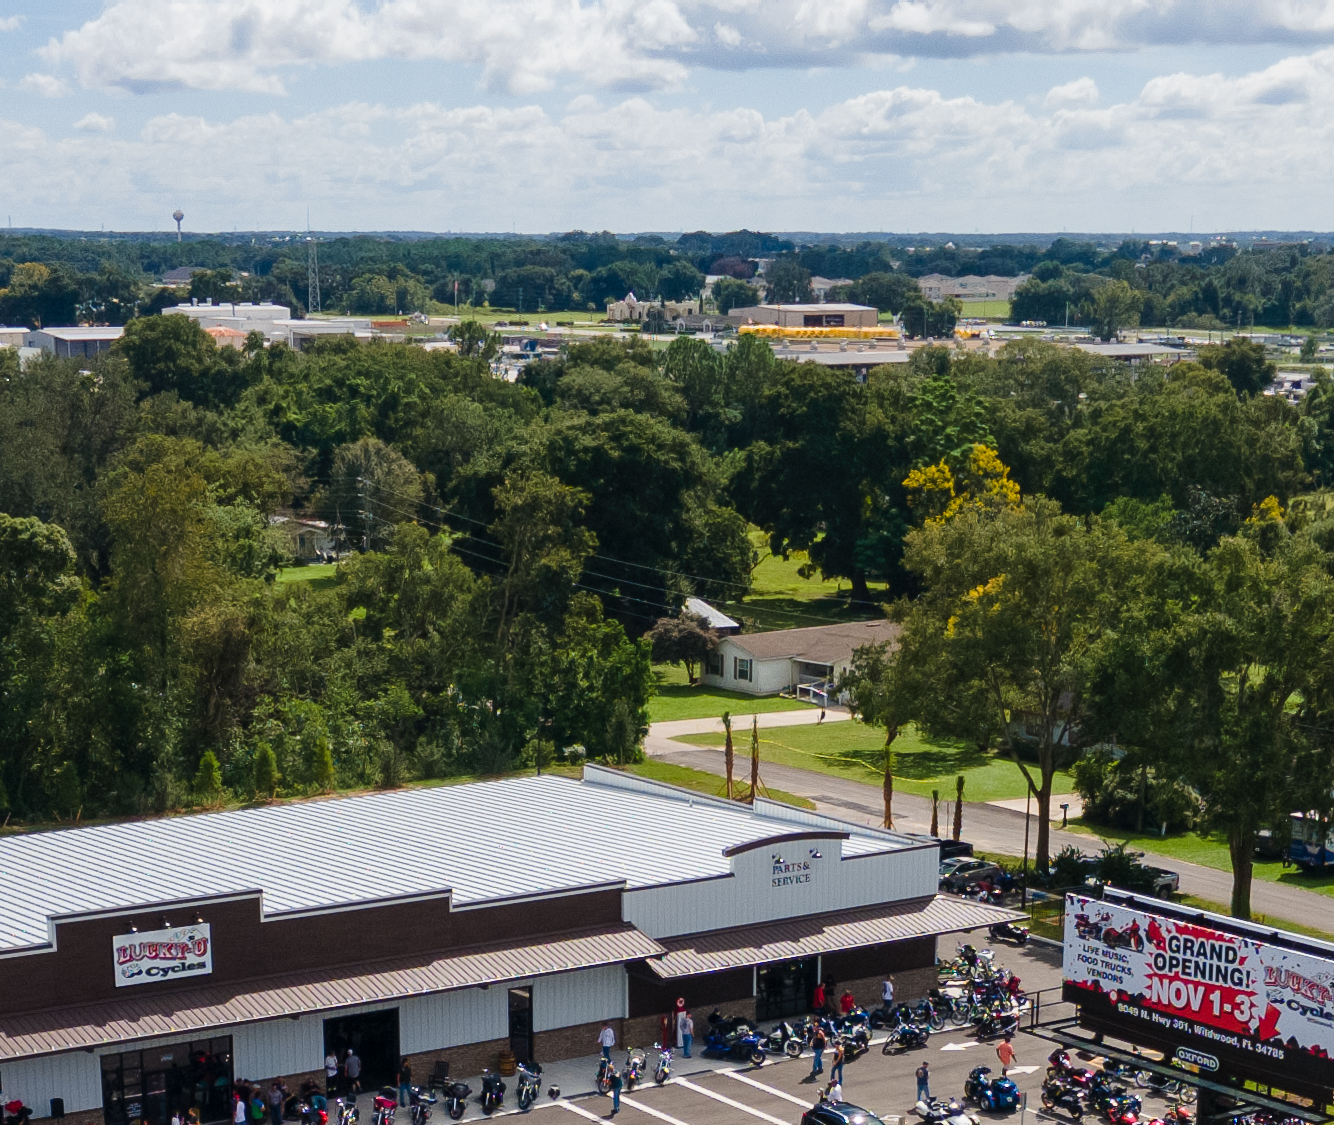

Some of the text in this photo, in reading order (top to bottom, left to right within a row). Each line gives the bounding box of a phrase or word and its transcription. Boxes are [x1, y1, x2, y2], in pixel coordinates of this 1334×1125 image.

[772, 863, 802, 875] PARTS
[772, 874, 811, 887] SERVICE
[1083, 943, 1100, 956] LIVE
[1168, 935, 1237, 964] GRAND
[145, 961, 207, 977] Cycles
[1077, 954, 1134, 978] FOOD TRUCKS,
[1154, 953, 1251, 988] OPENING!
[1087, 967, 1124, 985] VENDORS
[1151, 977, 1251, 1022] NOV 1-3
[1152, 1012, 1171, 1028] Hwy
[1172, 1019, 1192, 1034] 301,
[1194, 1024, 1240, 1048] Wildwood,
[1178, 1050, 1217, 1068] OXFORD
